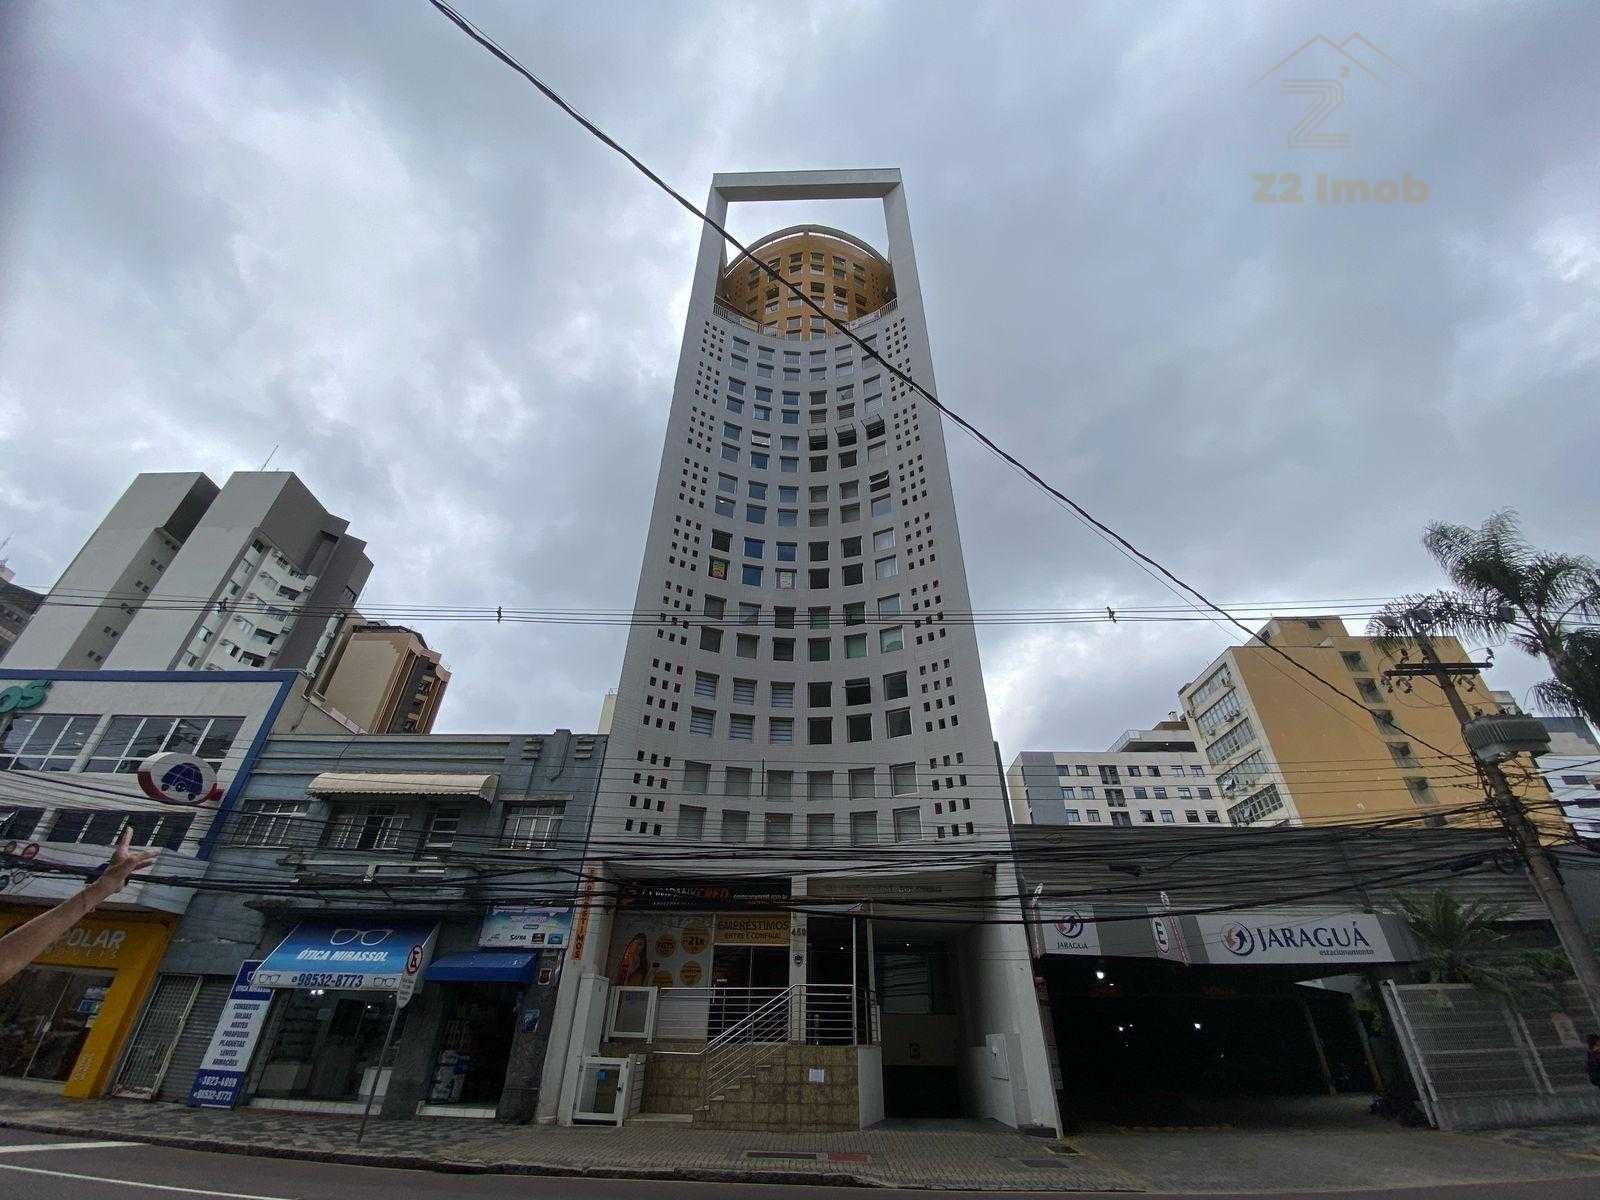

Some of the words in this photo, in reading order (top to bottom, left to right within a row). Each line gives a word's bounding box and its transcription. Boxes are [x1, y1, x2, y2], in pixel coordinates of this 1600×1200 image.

[1257, 921, 1370, 951] JARAGUÁ
[296, 947, 329, 961] ÓTICA
[330, 950, 389, 962] MIRASSOL
[298, 973, 364, 988] 98532-8773
